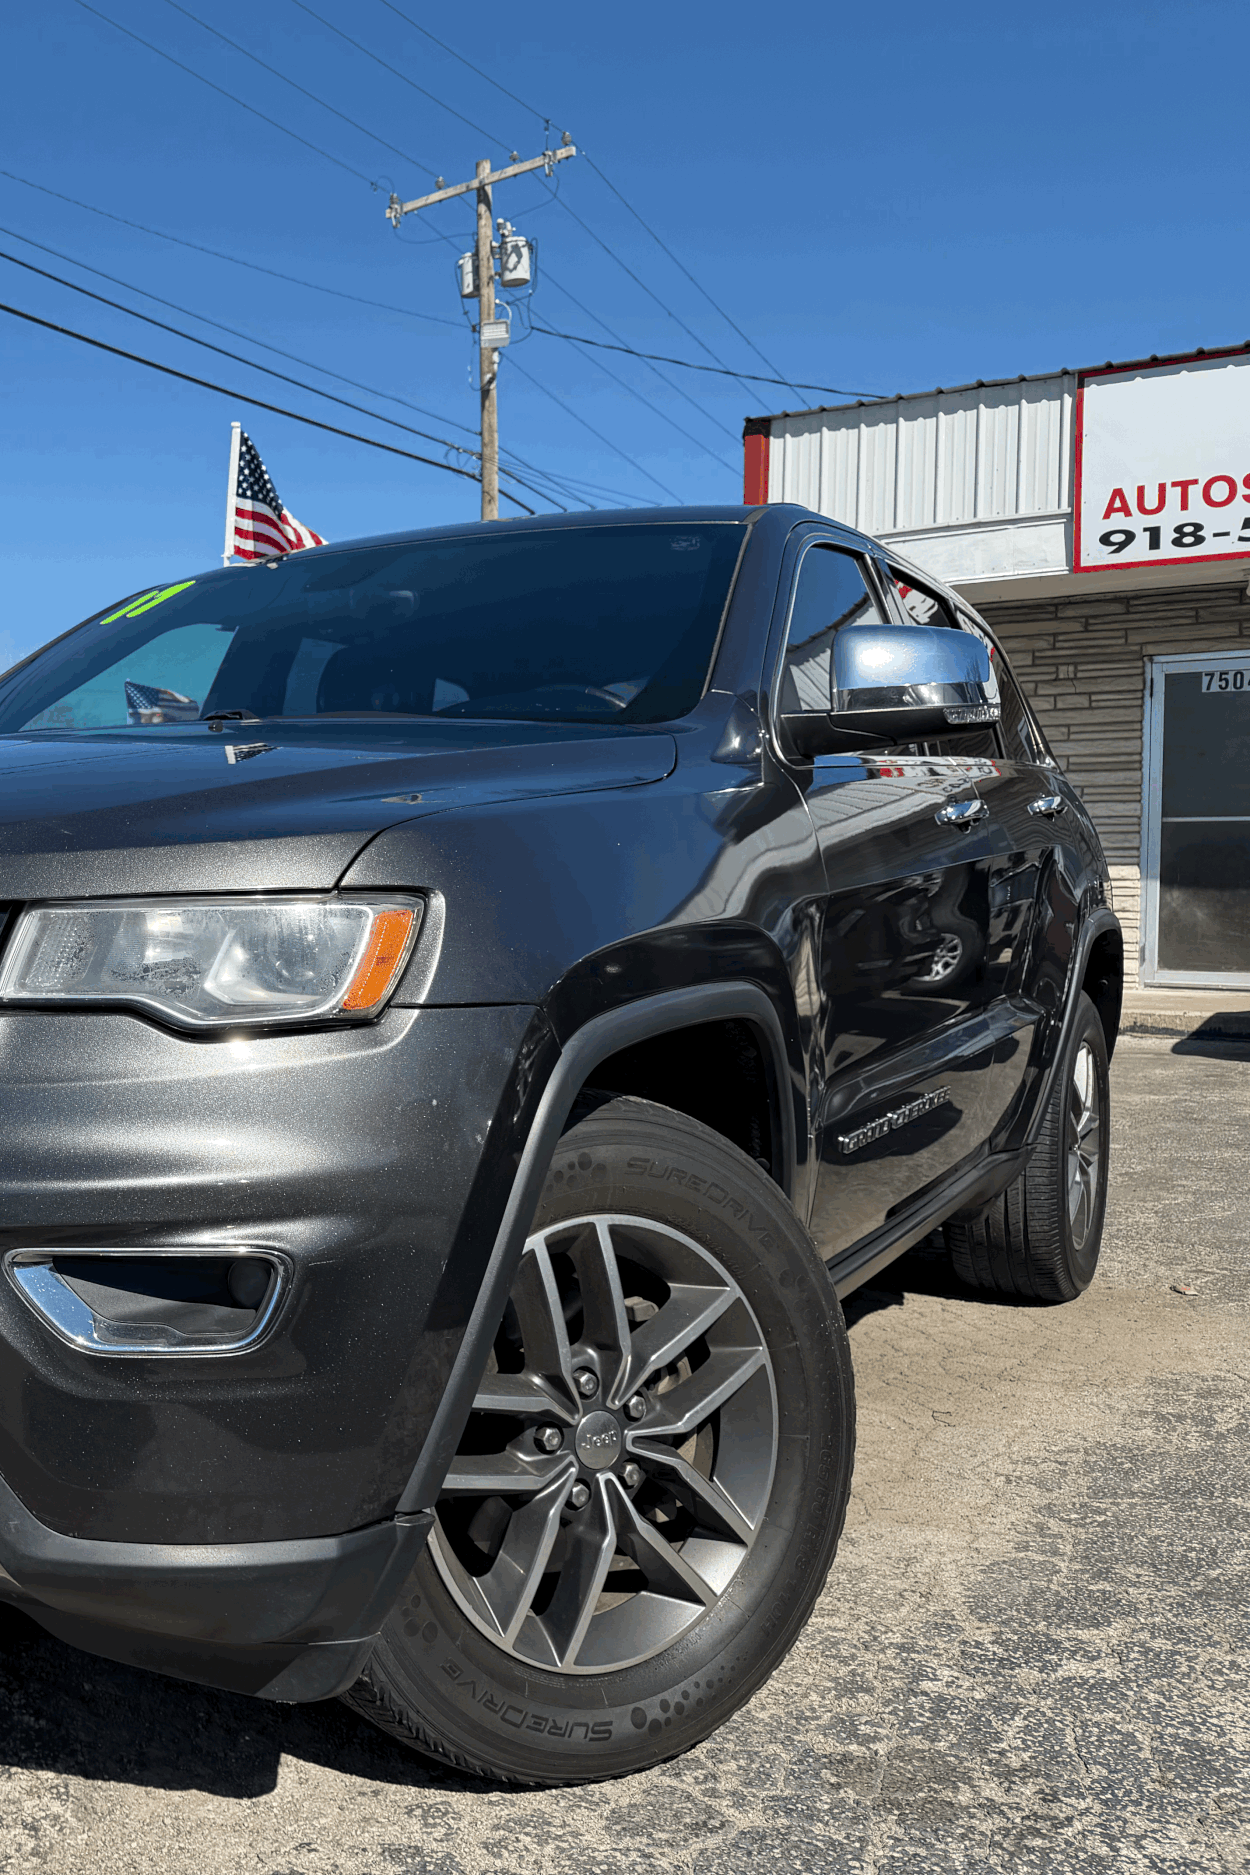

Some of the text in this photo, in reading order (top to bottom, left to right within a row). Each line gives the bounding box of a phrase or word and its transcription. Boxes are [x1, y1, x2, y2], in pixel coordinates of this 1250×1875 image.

[1102, 472, 1250, 520] AUTO
[1204, 671, 1250, 691] 750
[581, 1430, 618, 1450] Jeep
[439, 1656, 614, 1742] SUREDRIVE
